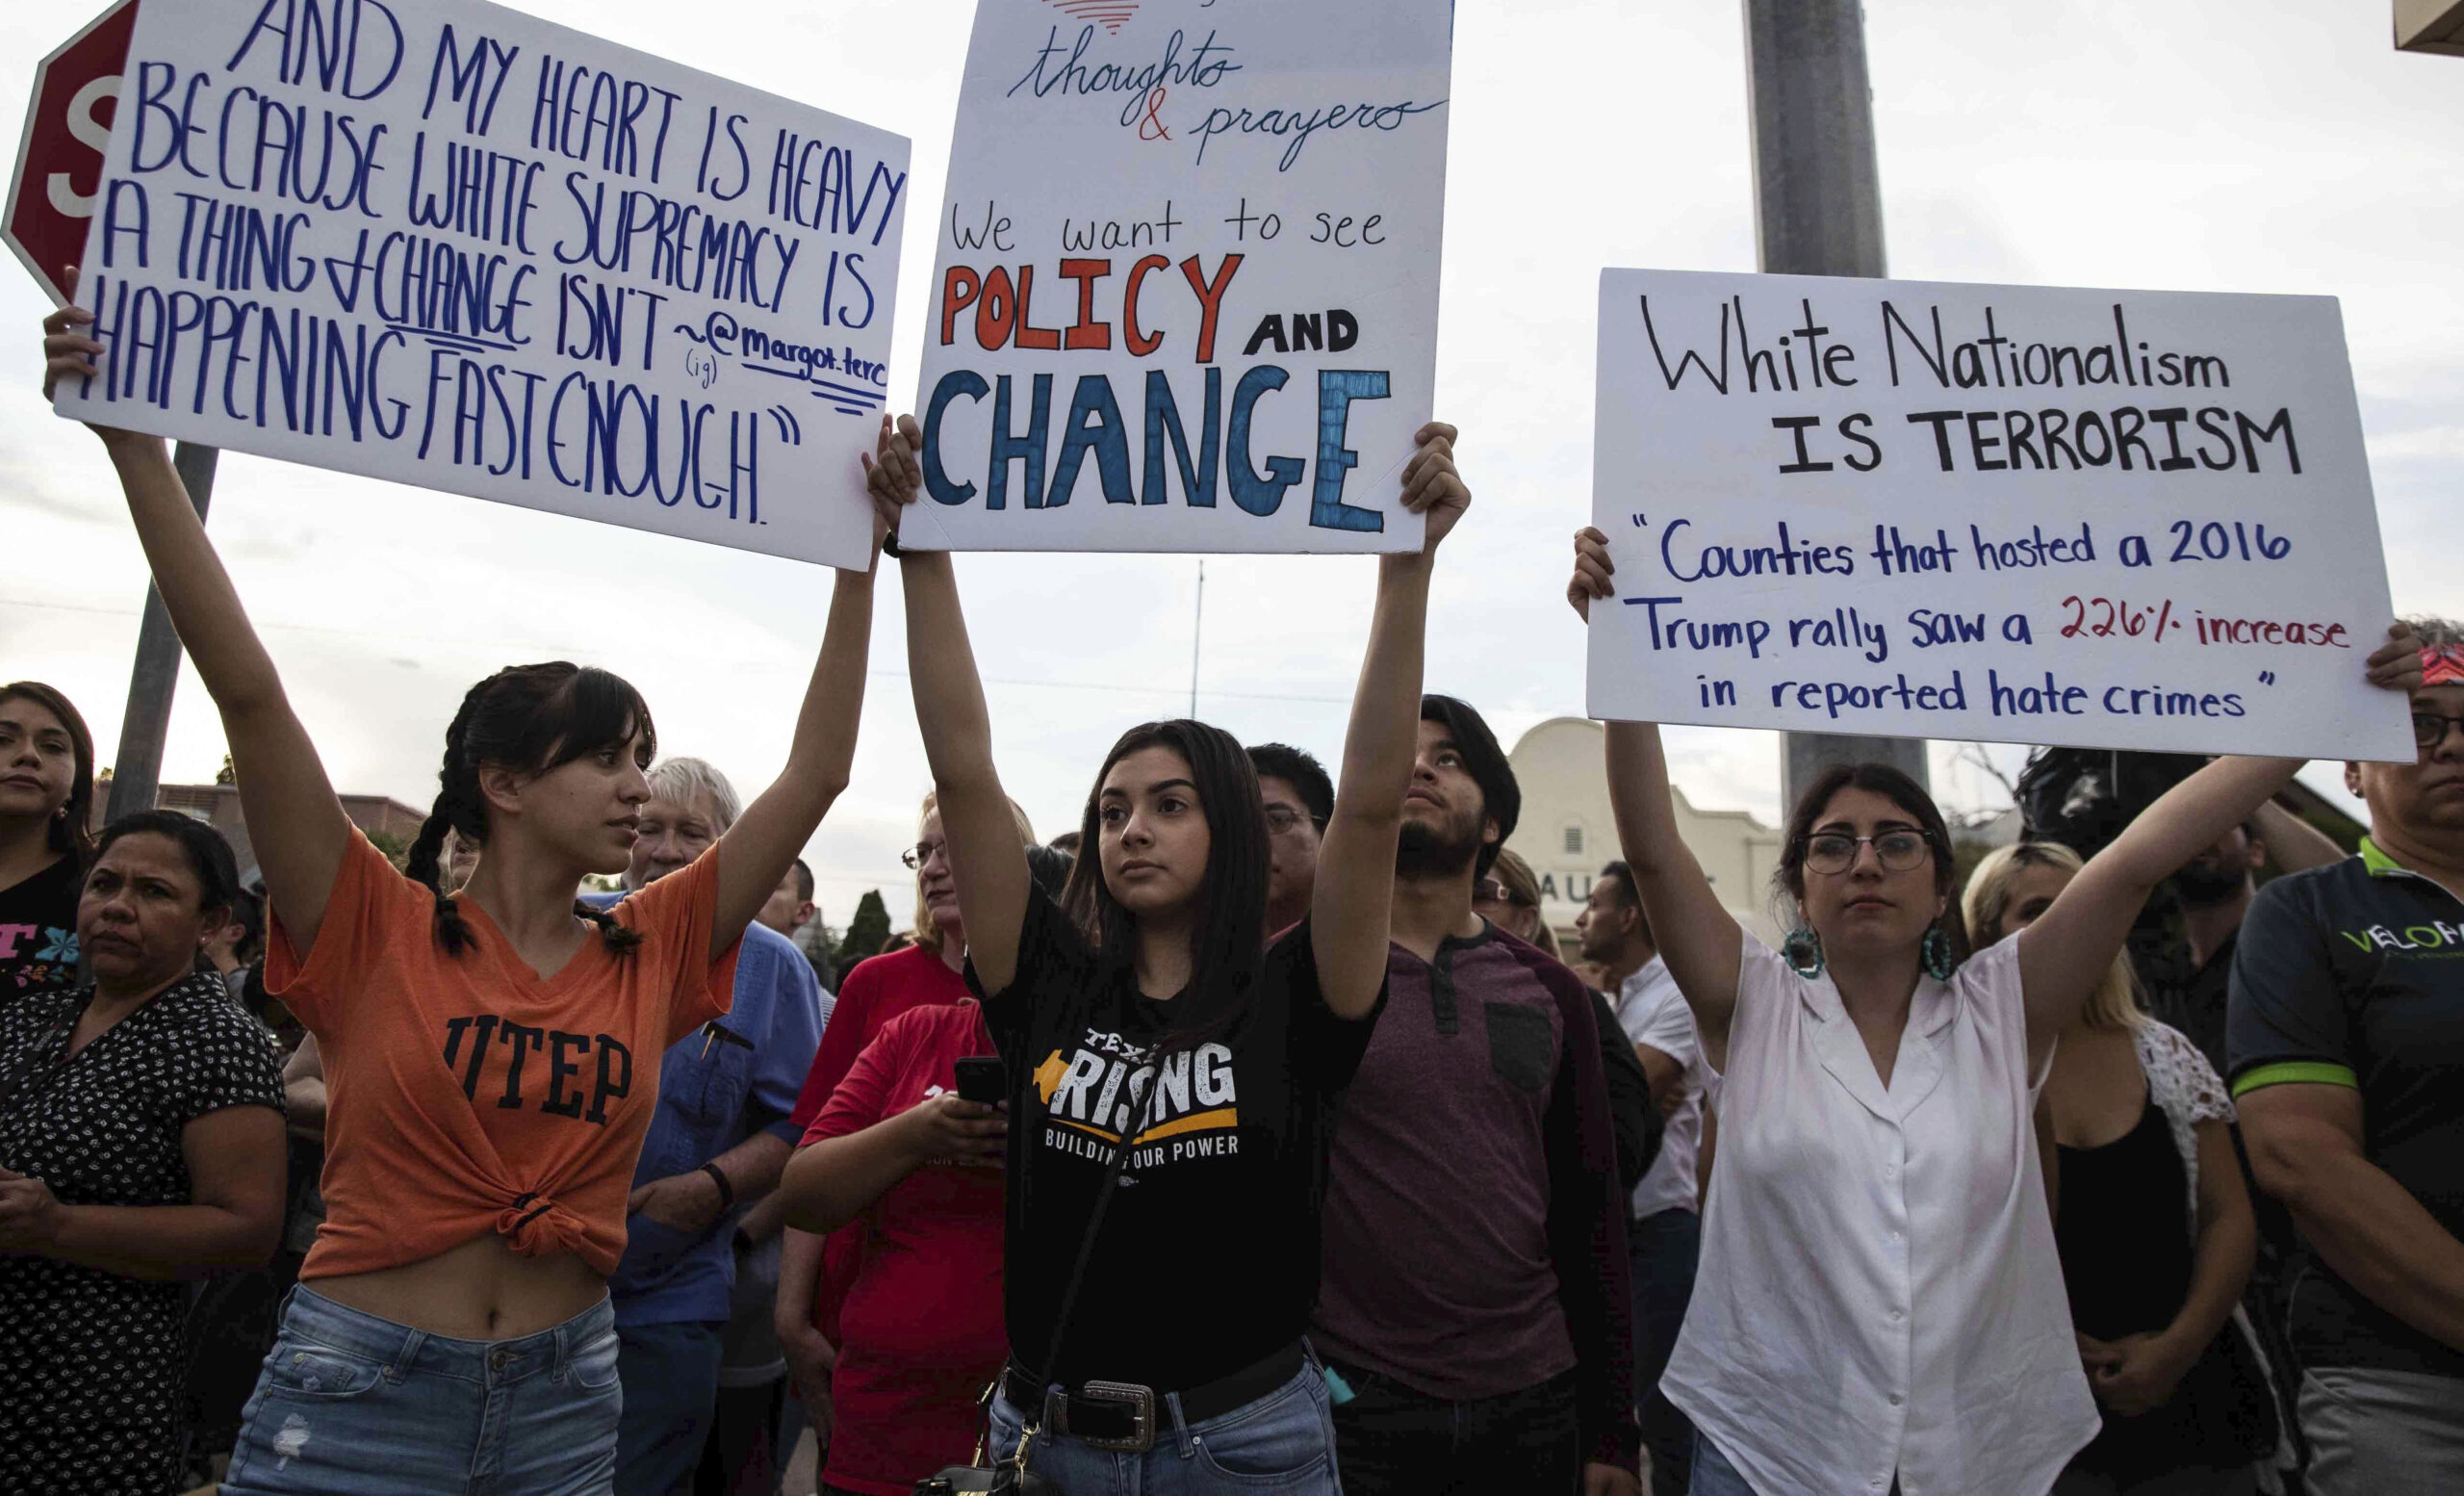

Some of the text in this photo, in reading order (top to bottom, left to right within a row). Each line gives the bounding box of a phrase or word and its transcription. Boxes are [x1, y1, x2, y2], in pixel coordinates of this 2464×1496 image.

[227, 0, 907, 246] AND MY HEART IS HEAVY
[1008, 24, 1244, 126] thoughts
[1139, 88, 1450, 172] & prayers
[131, 61, 875, 329] BECAUSE WHITE SUPREMACY IS
[951, 197, 1387, 252] We want to see
[102, 179, 149, 269] A
[173, 192, 316, 293] THING
[374, 231, 538, 345] CHANGE
[555, 271, 669, 371] ISN'T
[940, 253, 1359, 364] POLICY AND
[80, 274, 412, 442] HAPPENING
[418, 348, 547, 480] FAST
[1640, 294, 2231, 396] White Nationalism
[921, 364, 1392, 534] CHANGE
[1771, 406, 2302, 475] IS TERRORISM
[1870, 524, 1959, 576] that
[1969, 521, 2096, 571] hosted
[2118, 535, 2152, 567] a
[2169, 520, 2292, 562] 2016
[1622, 596, 1771, 658] Trump
[1788, 606, 1888, 664] rally
[1908, 611, 1986, 649] saw
[2001, 613, 2034, 646] a
[2194, 609, 2351, 649] increase
[1696, 674, 1737, 709] in
[1771, 669, 1968, 719] reported
[1988, 668, 2090, 717] hate
[442, 1014, 633, 1126] UTEP
[1049, 1042, 1237, 1135] RISNG
[1044, 1127, 1240, 1171] BUILDIN OUR POWER
